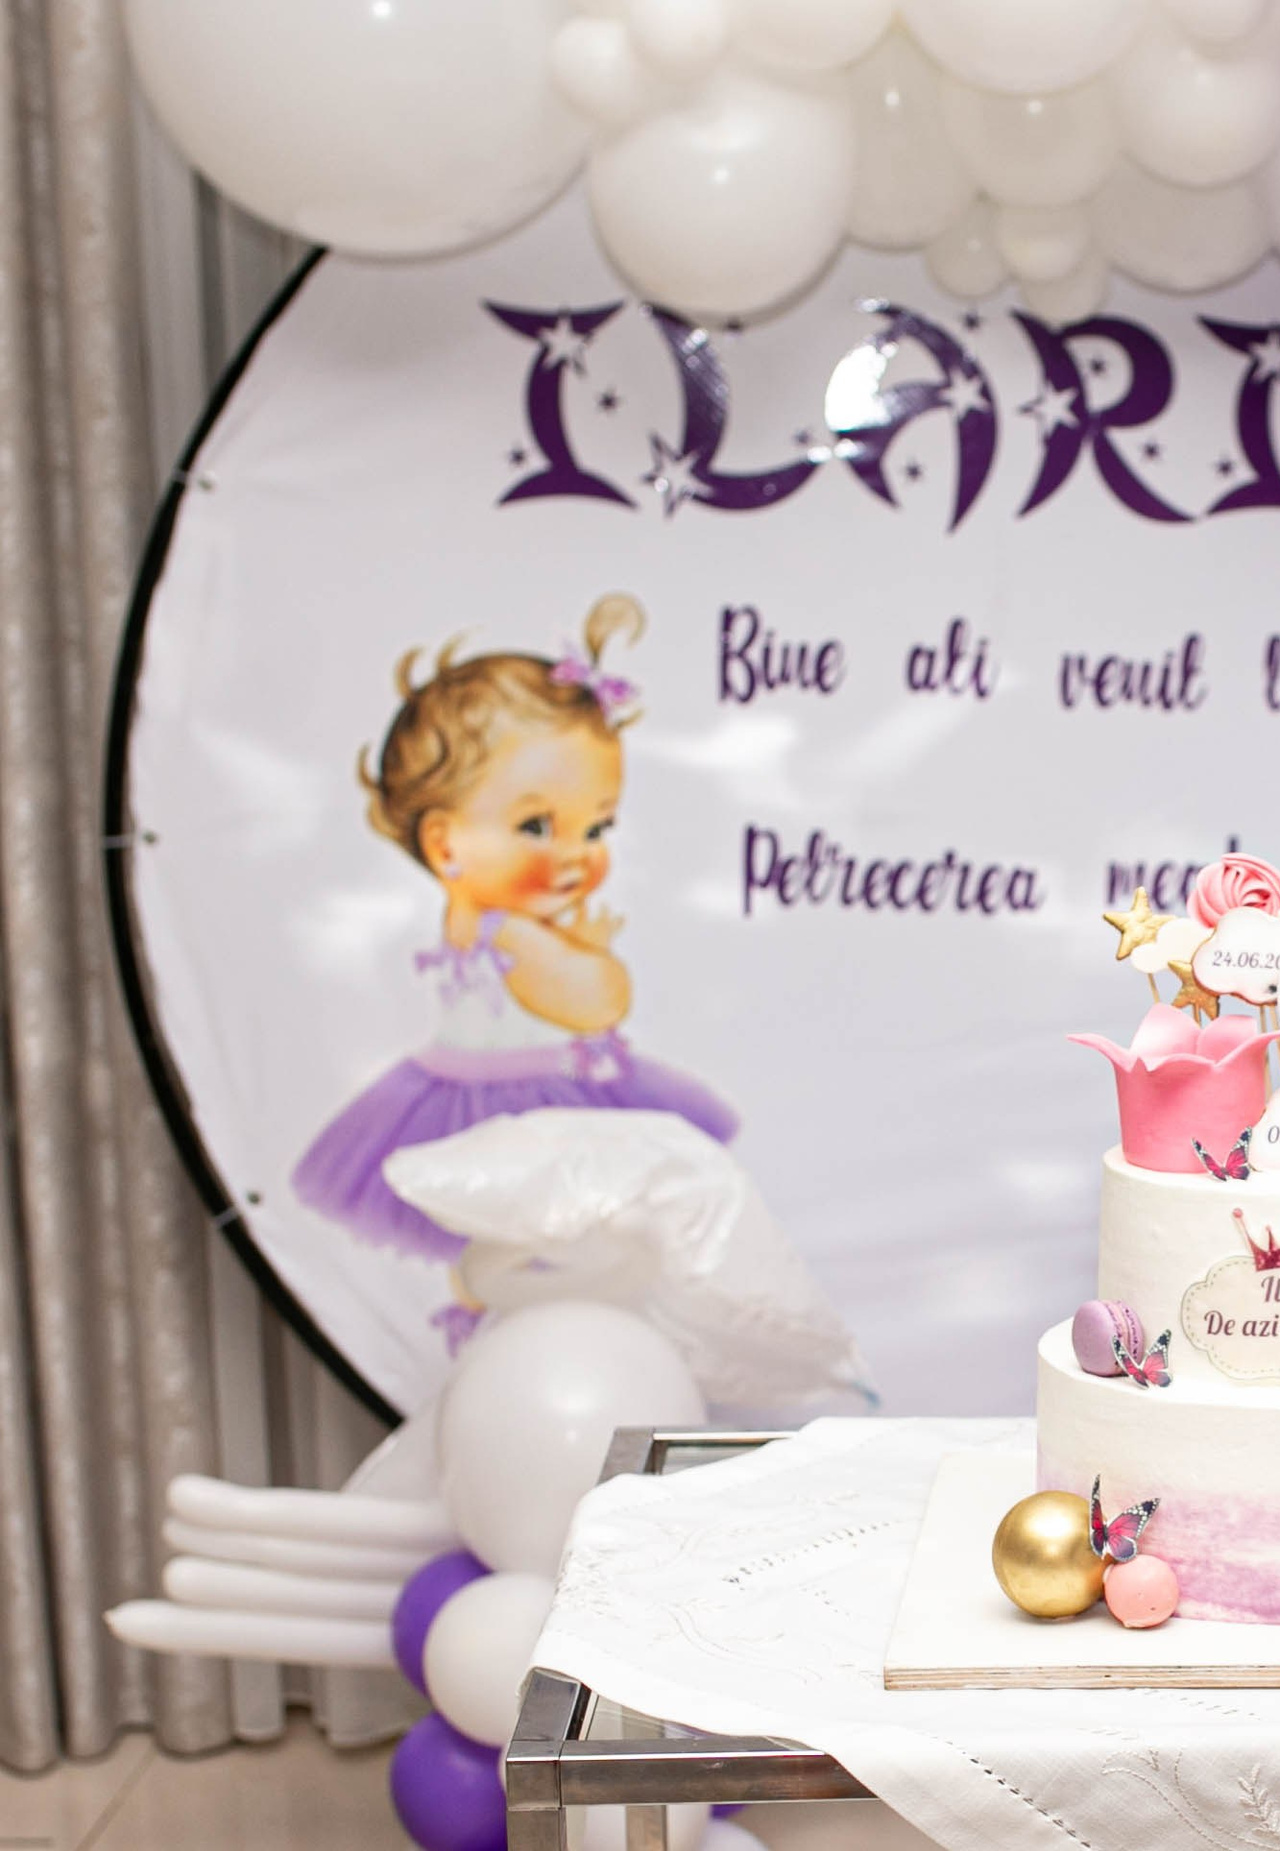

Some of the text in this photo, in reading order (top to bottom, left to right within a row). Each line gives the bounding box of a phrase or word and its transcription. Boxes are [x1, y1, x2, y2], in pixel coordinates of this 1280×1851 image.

[720, 605, 845, 702] Bine
[1060, 631, 1205, 710] venit
[1203, 1310, 1236, 1336] De
[1242, 1314, 1280, 1337] azi
